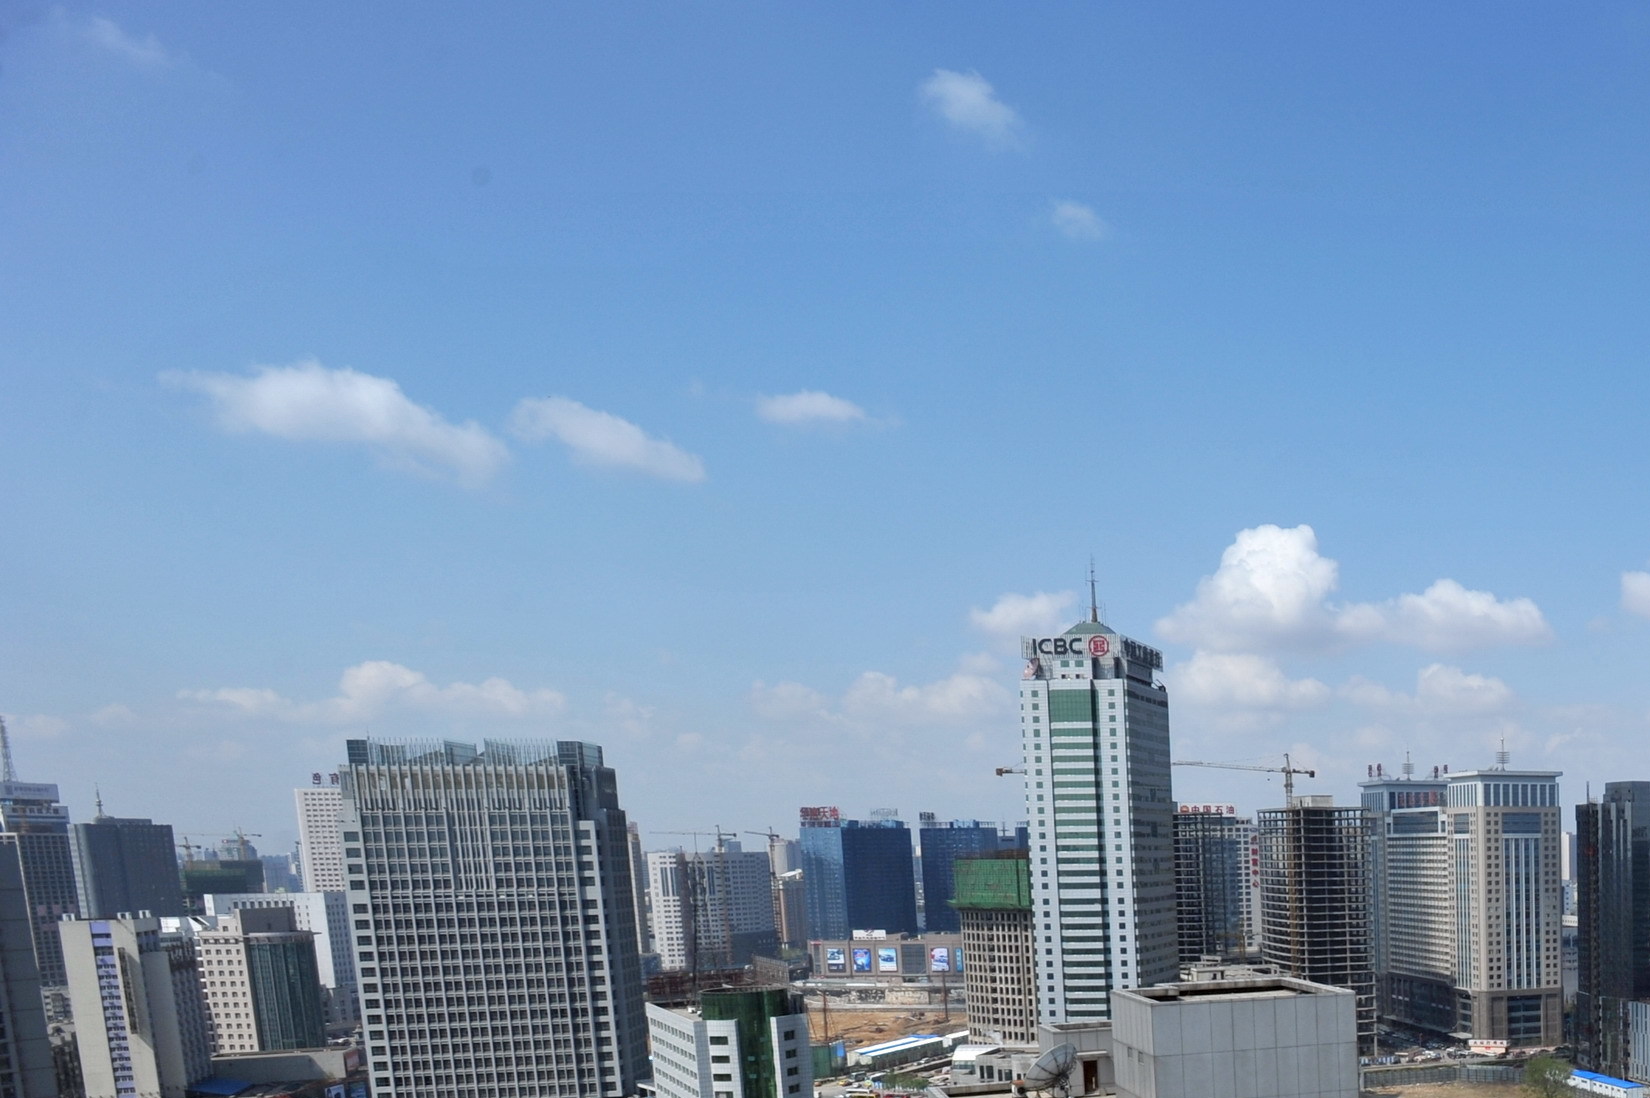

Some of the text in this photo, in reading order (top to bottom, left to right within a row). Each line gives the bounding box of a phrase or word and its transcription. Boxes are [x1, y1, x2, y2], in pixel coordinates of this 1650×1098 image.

[1032, 638, 1083, 656] ICBC
[1191, 804, 1235, 816] 中国石油
